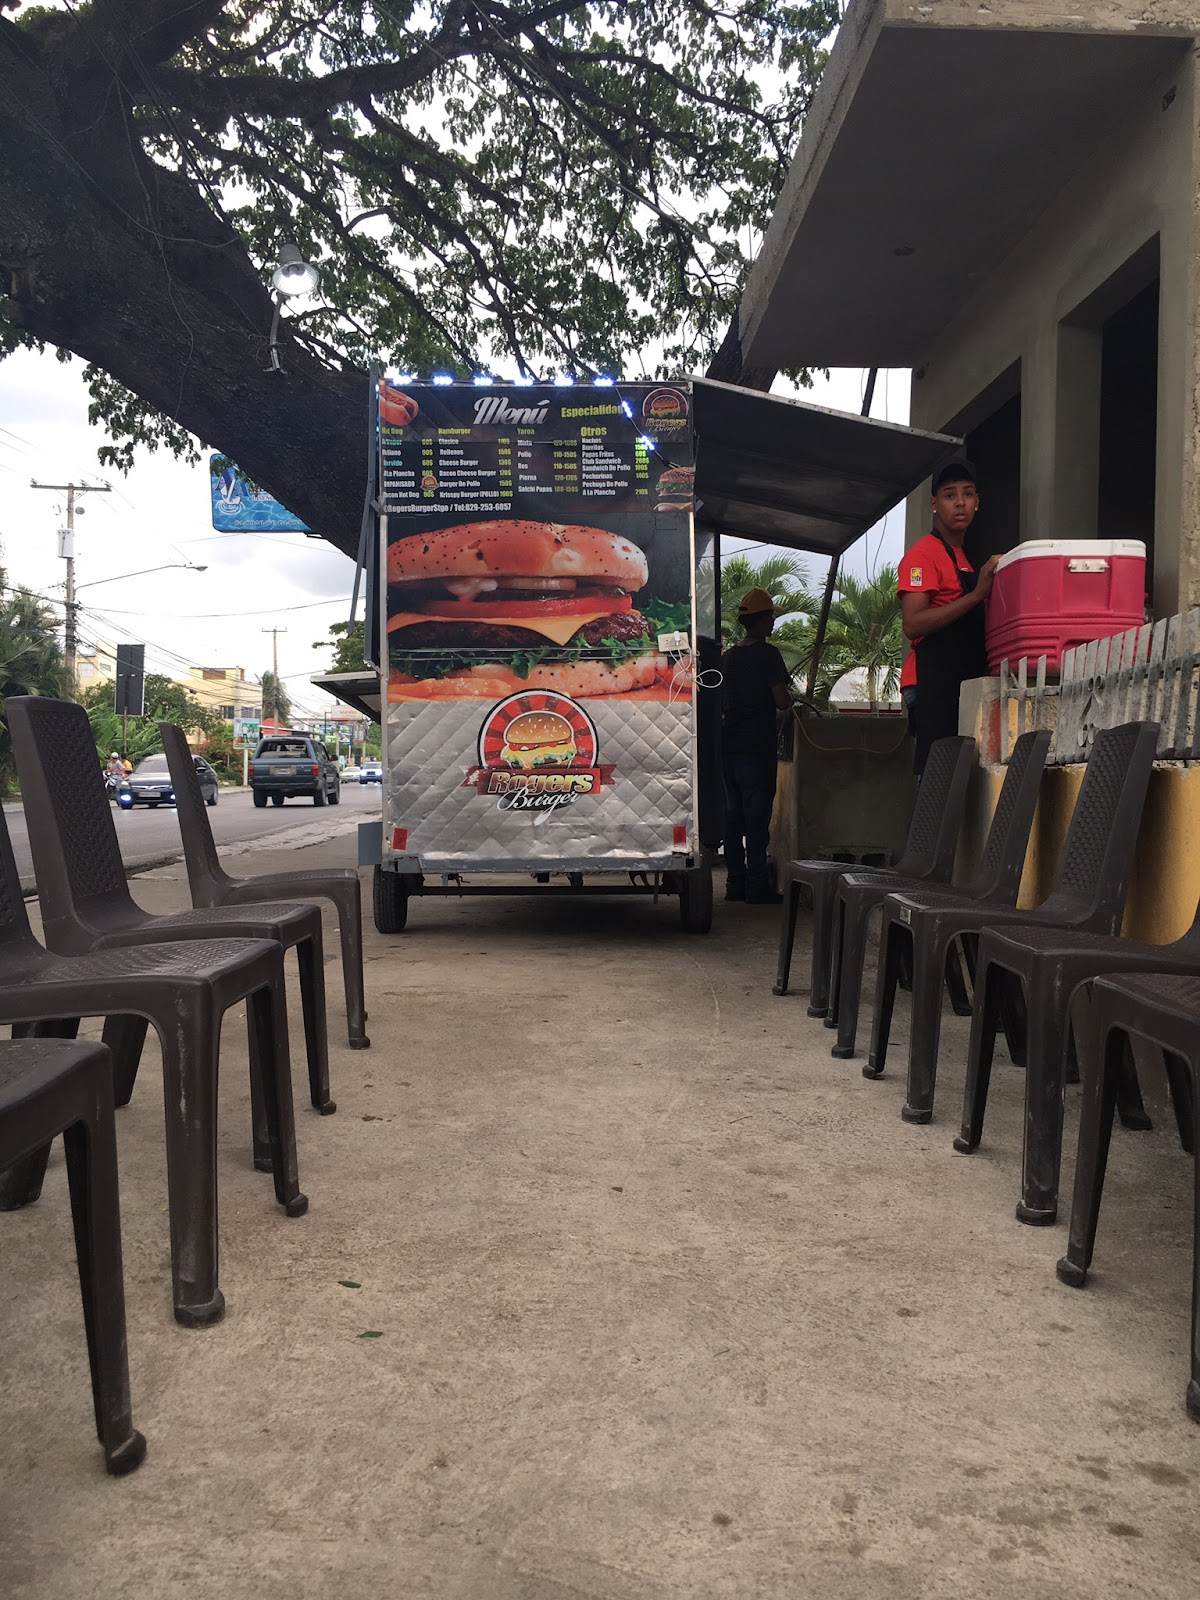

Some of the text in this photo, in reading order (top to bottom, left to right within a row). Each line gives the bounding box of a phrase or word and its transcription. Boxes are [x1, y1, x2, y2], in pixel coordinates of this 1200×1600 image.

[473, 396, 550, 424] Menú
[581, 426, 607, 437] Otros
[454, 503, 512, 512] Tel:829-253-6057
[488, 772, 594, 794] Rogers
[496, 784, 581, 826] Burger
